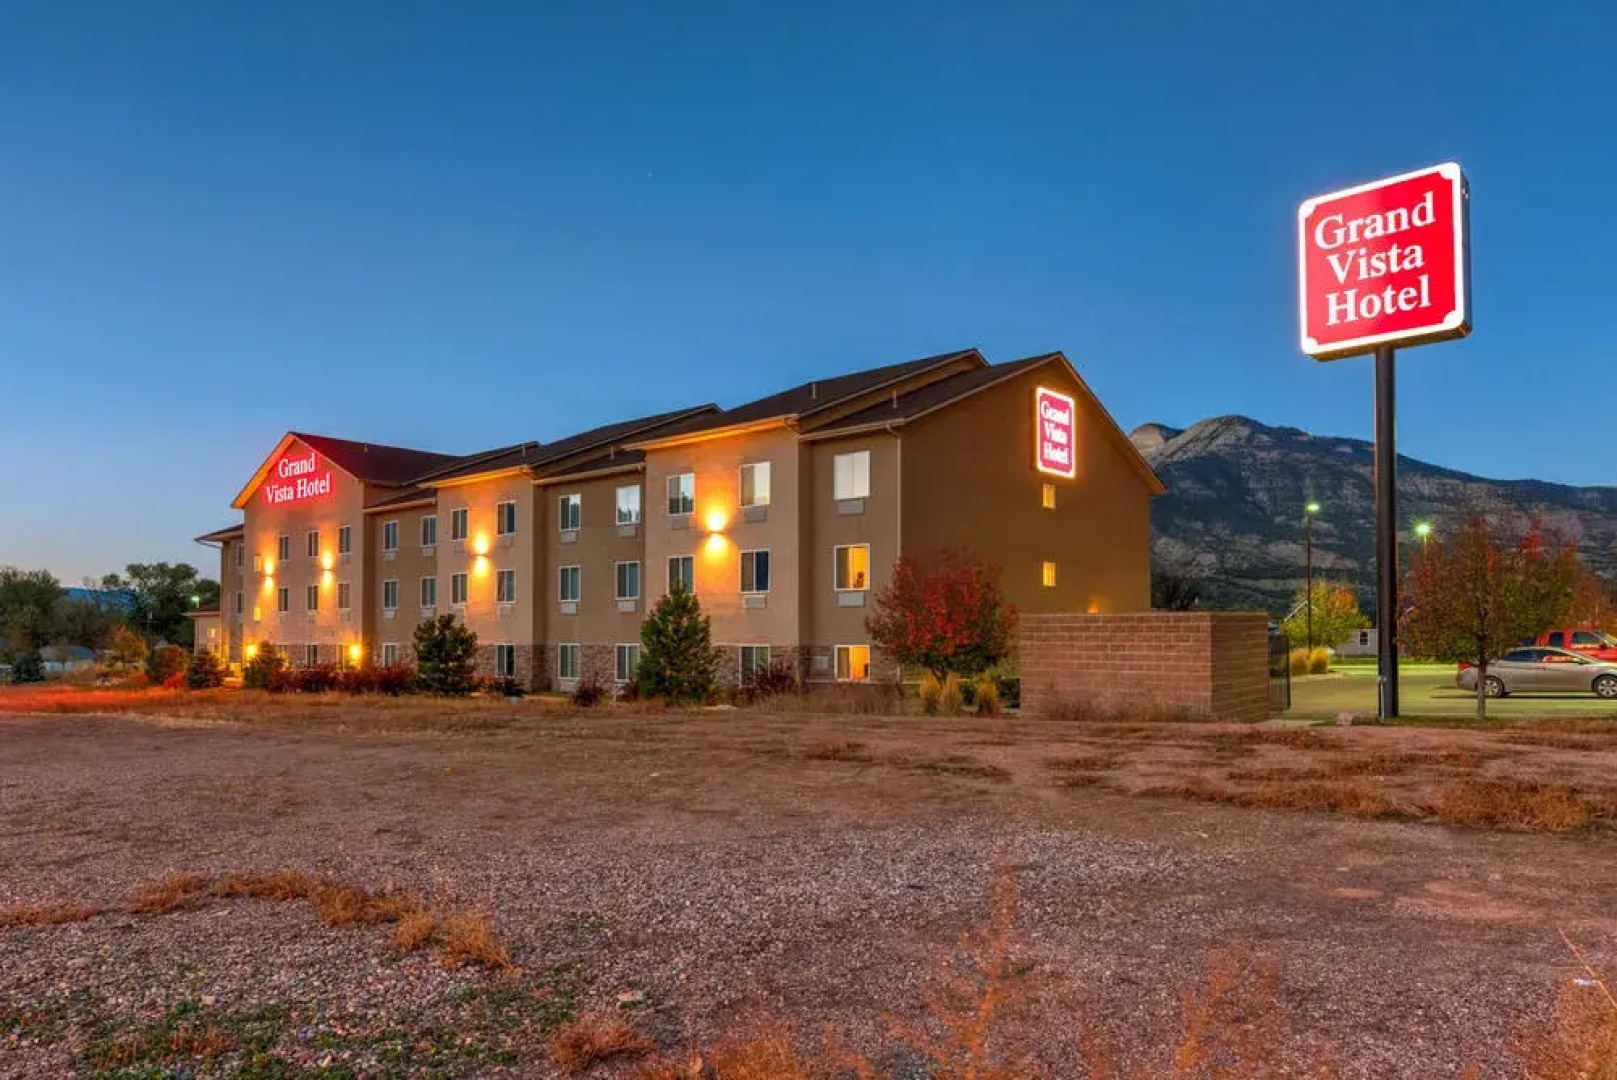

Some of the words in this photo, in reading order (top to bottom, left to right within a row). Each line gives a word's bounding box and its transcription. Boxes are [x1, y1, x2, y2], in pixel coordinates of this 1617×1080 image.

[1315, 191, 1436, 250] Grand
[1326, 243, 1425, 284] Vista
[1325, 275, 1431, 326] Hotel
[278, 452, 316, 478] Grand
[265, 485, 294, 504] Vista
[297, 472, 331, 499] Hotel
